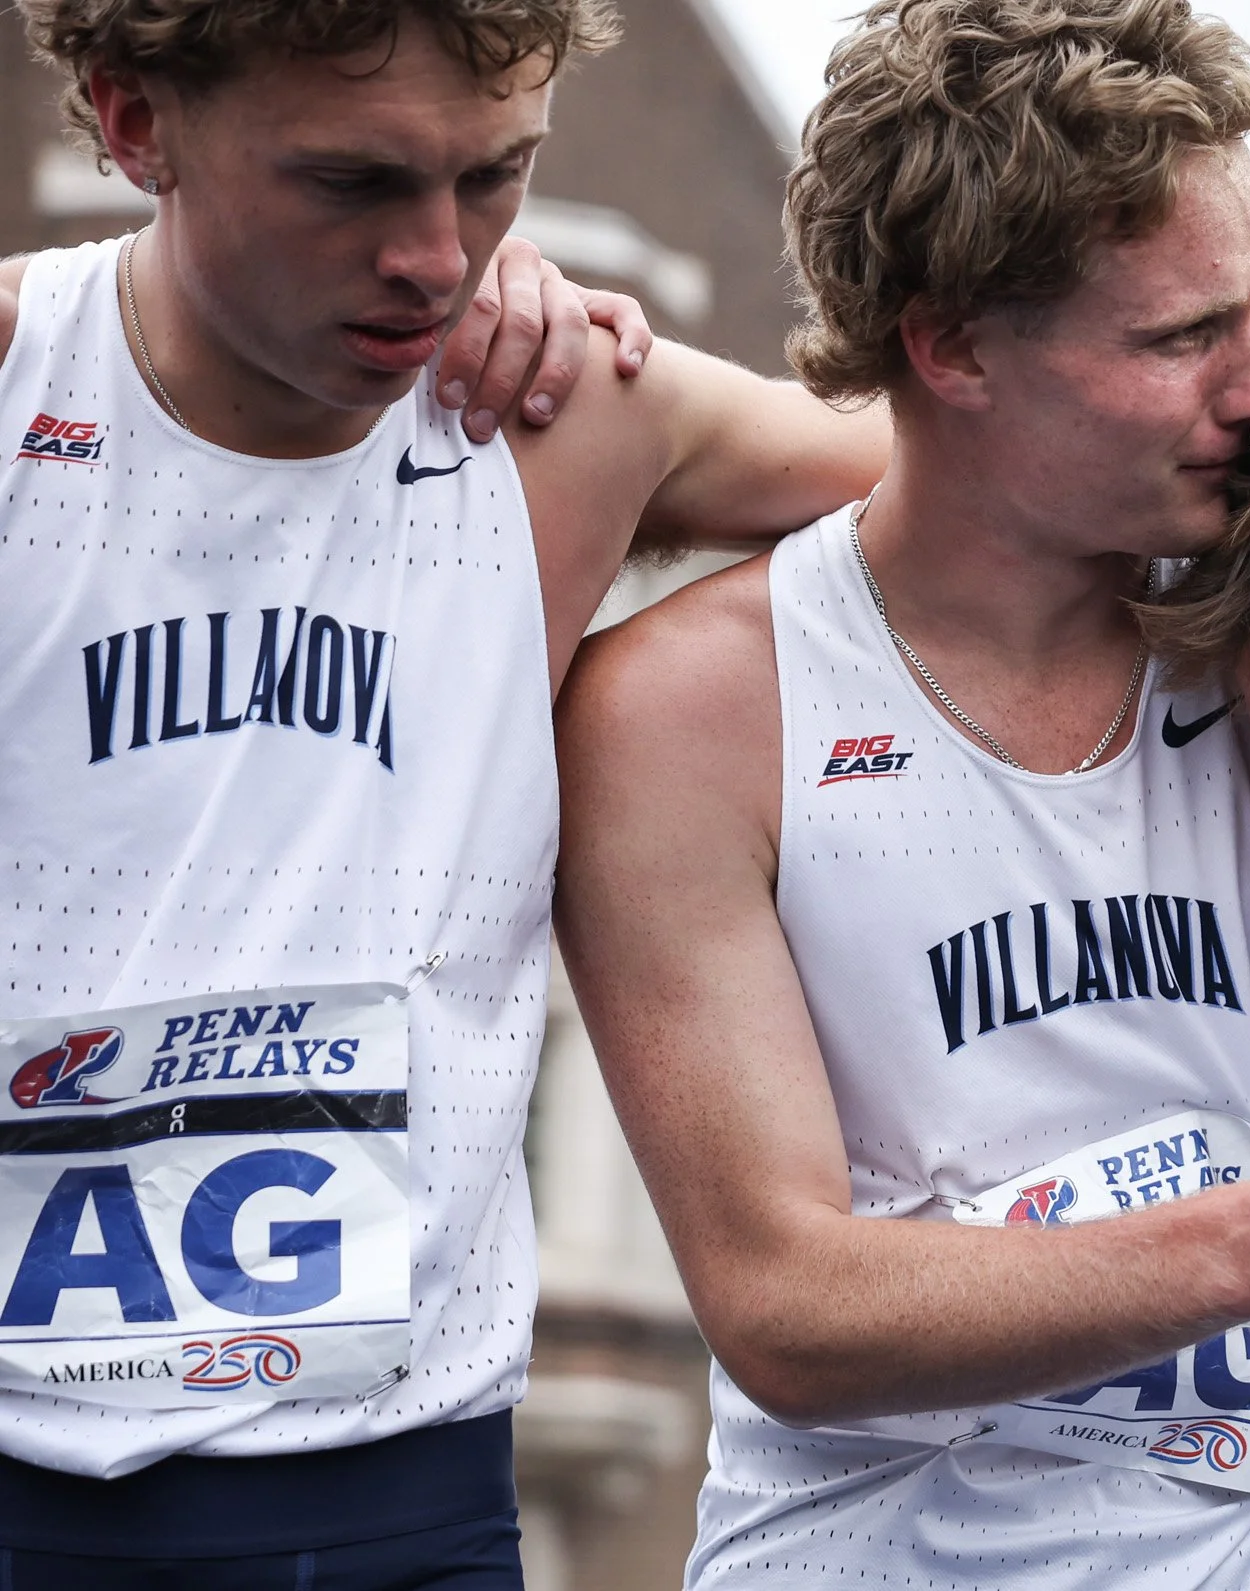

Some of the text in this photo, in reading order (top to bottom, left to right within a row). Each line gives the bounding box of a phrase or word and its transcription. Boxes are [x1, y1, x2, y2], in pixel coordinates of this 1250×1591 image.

[20, 431, 106, 460] EAST
[28, 412, 98, 441] BIG
[821, 752, 914, 777] EAST
[830, 734, 896, 758] BIG
[926, 892, 1247, 1055] VILLANOVA
[156, 1001, 316, 1053] PENN
[141, 1038, 360, 1092] RELAYS
[1097, 1128, 1211, 1186] PENN
[1110, 1165, 1242, 1214] RELAS
[0, 1148, 342, 1327] AG
[43, 1333, 302, 1392] AMERICA 250
[1049, 1419, 1248, 1473] AMERICA 250
